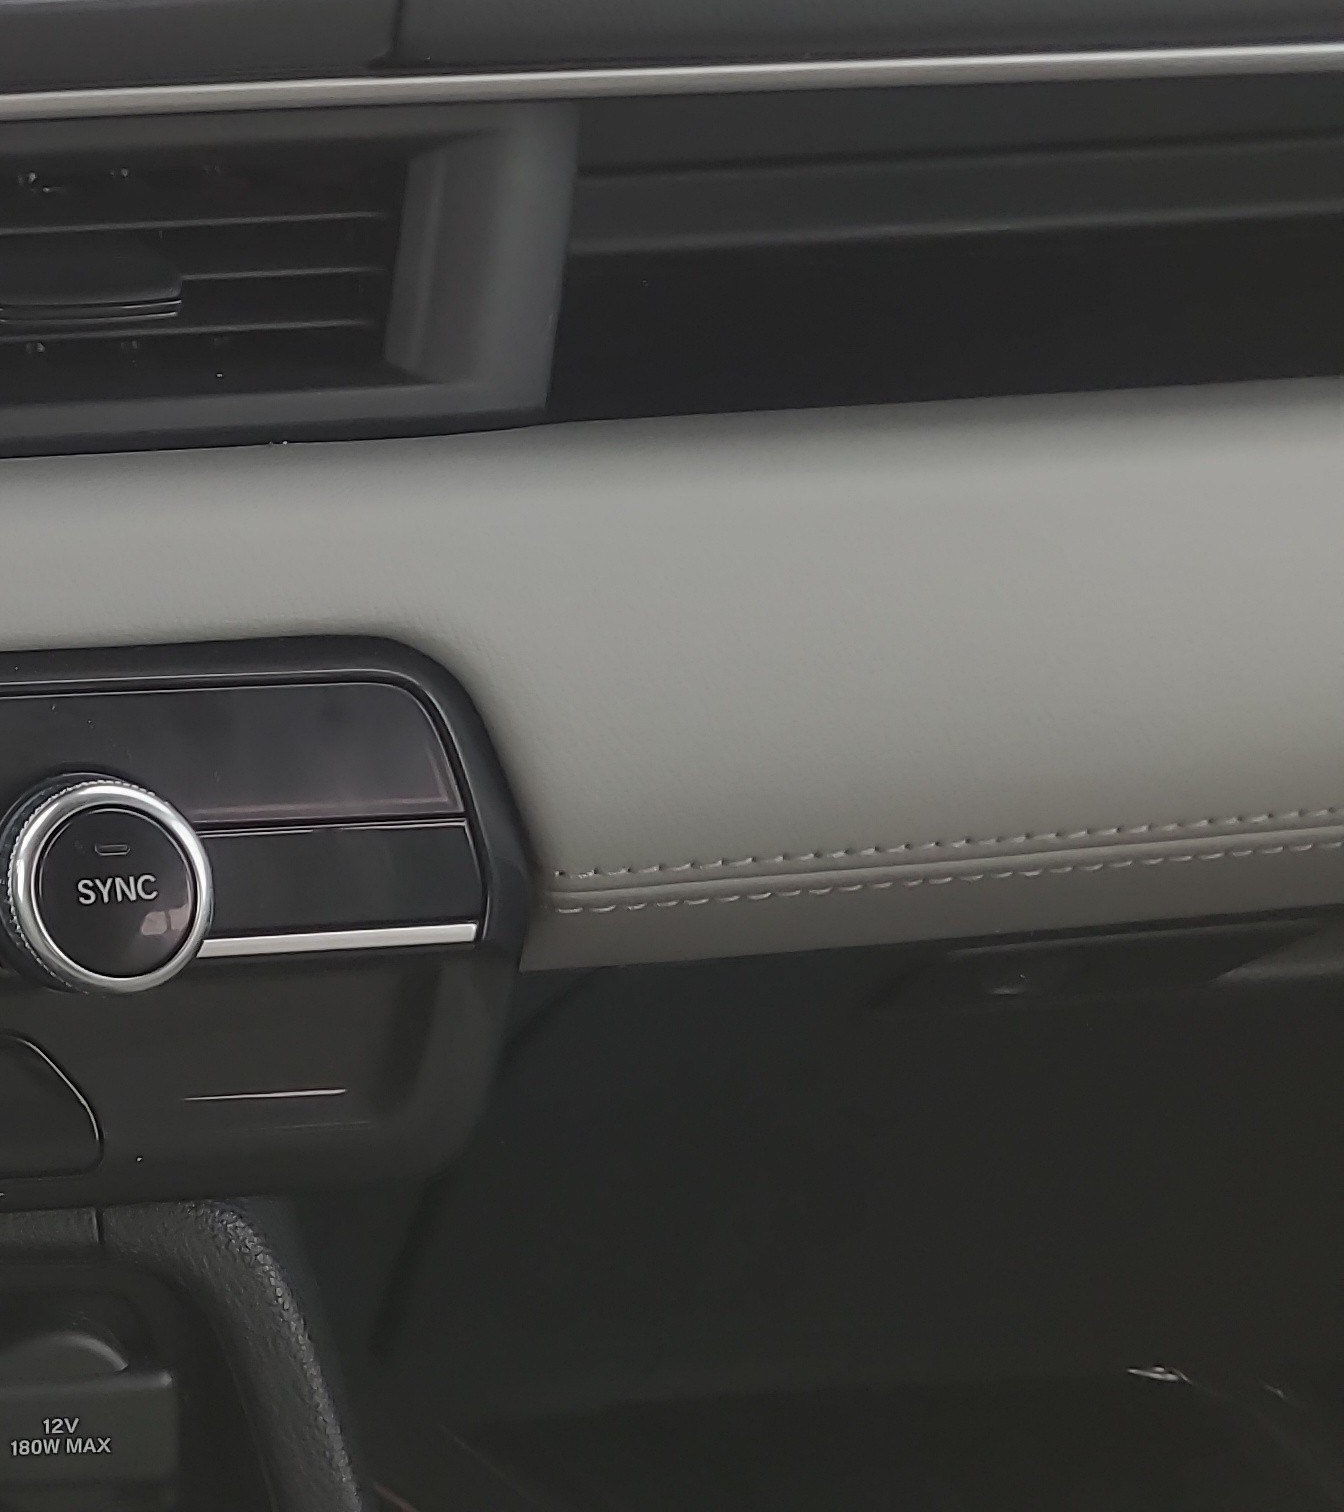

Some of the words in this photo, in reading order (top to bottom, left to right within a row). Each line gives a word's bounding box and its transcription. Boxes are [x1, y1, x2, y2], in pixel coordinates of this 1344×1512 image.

[77, 874, 158, 905] SYNC
[42, 1417, 80, 1436] 12V
[10, 1438, 61, 1456] 180W
[66, 1437, 111, 1454] MAX
